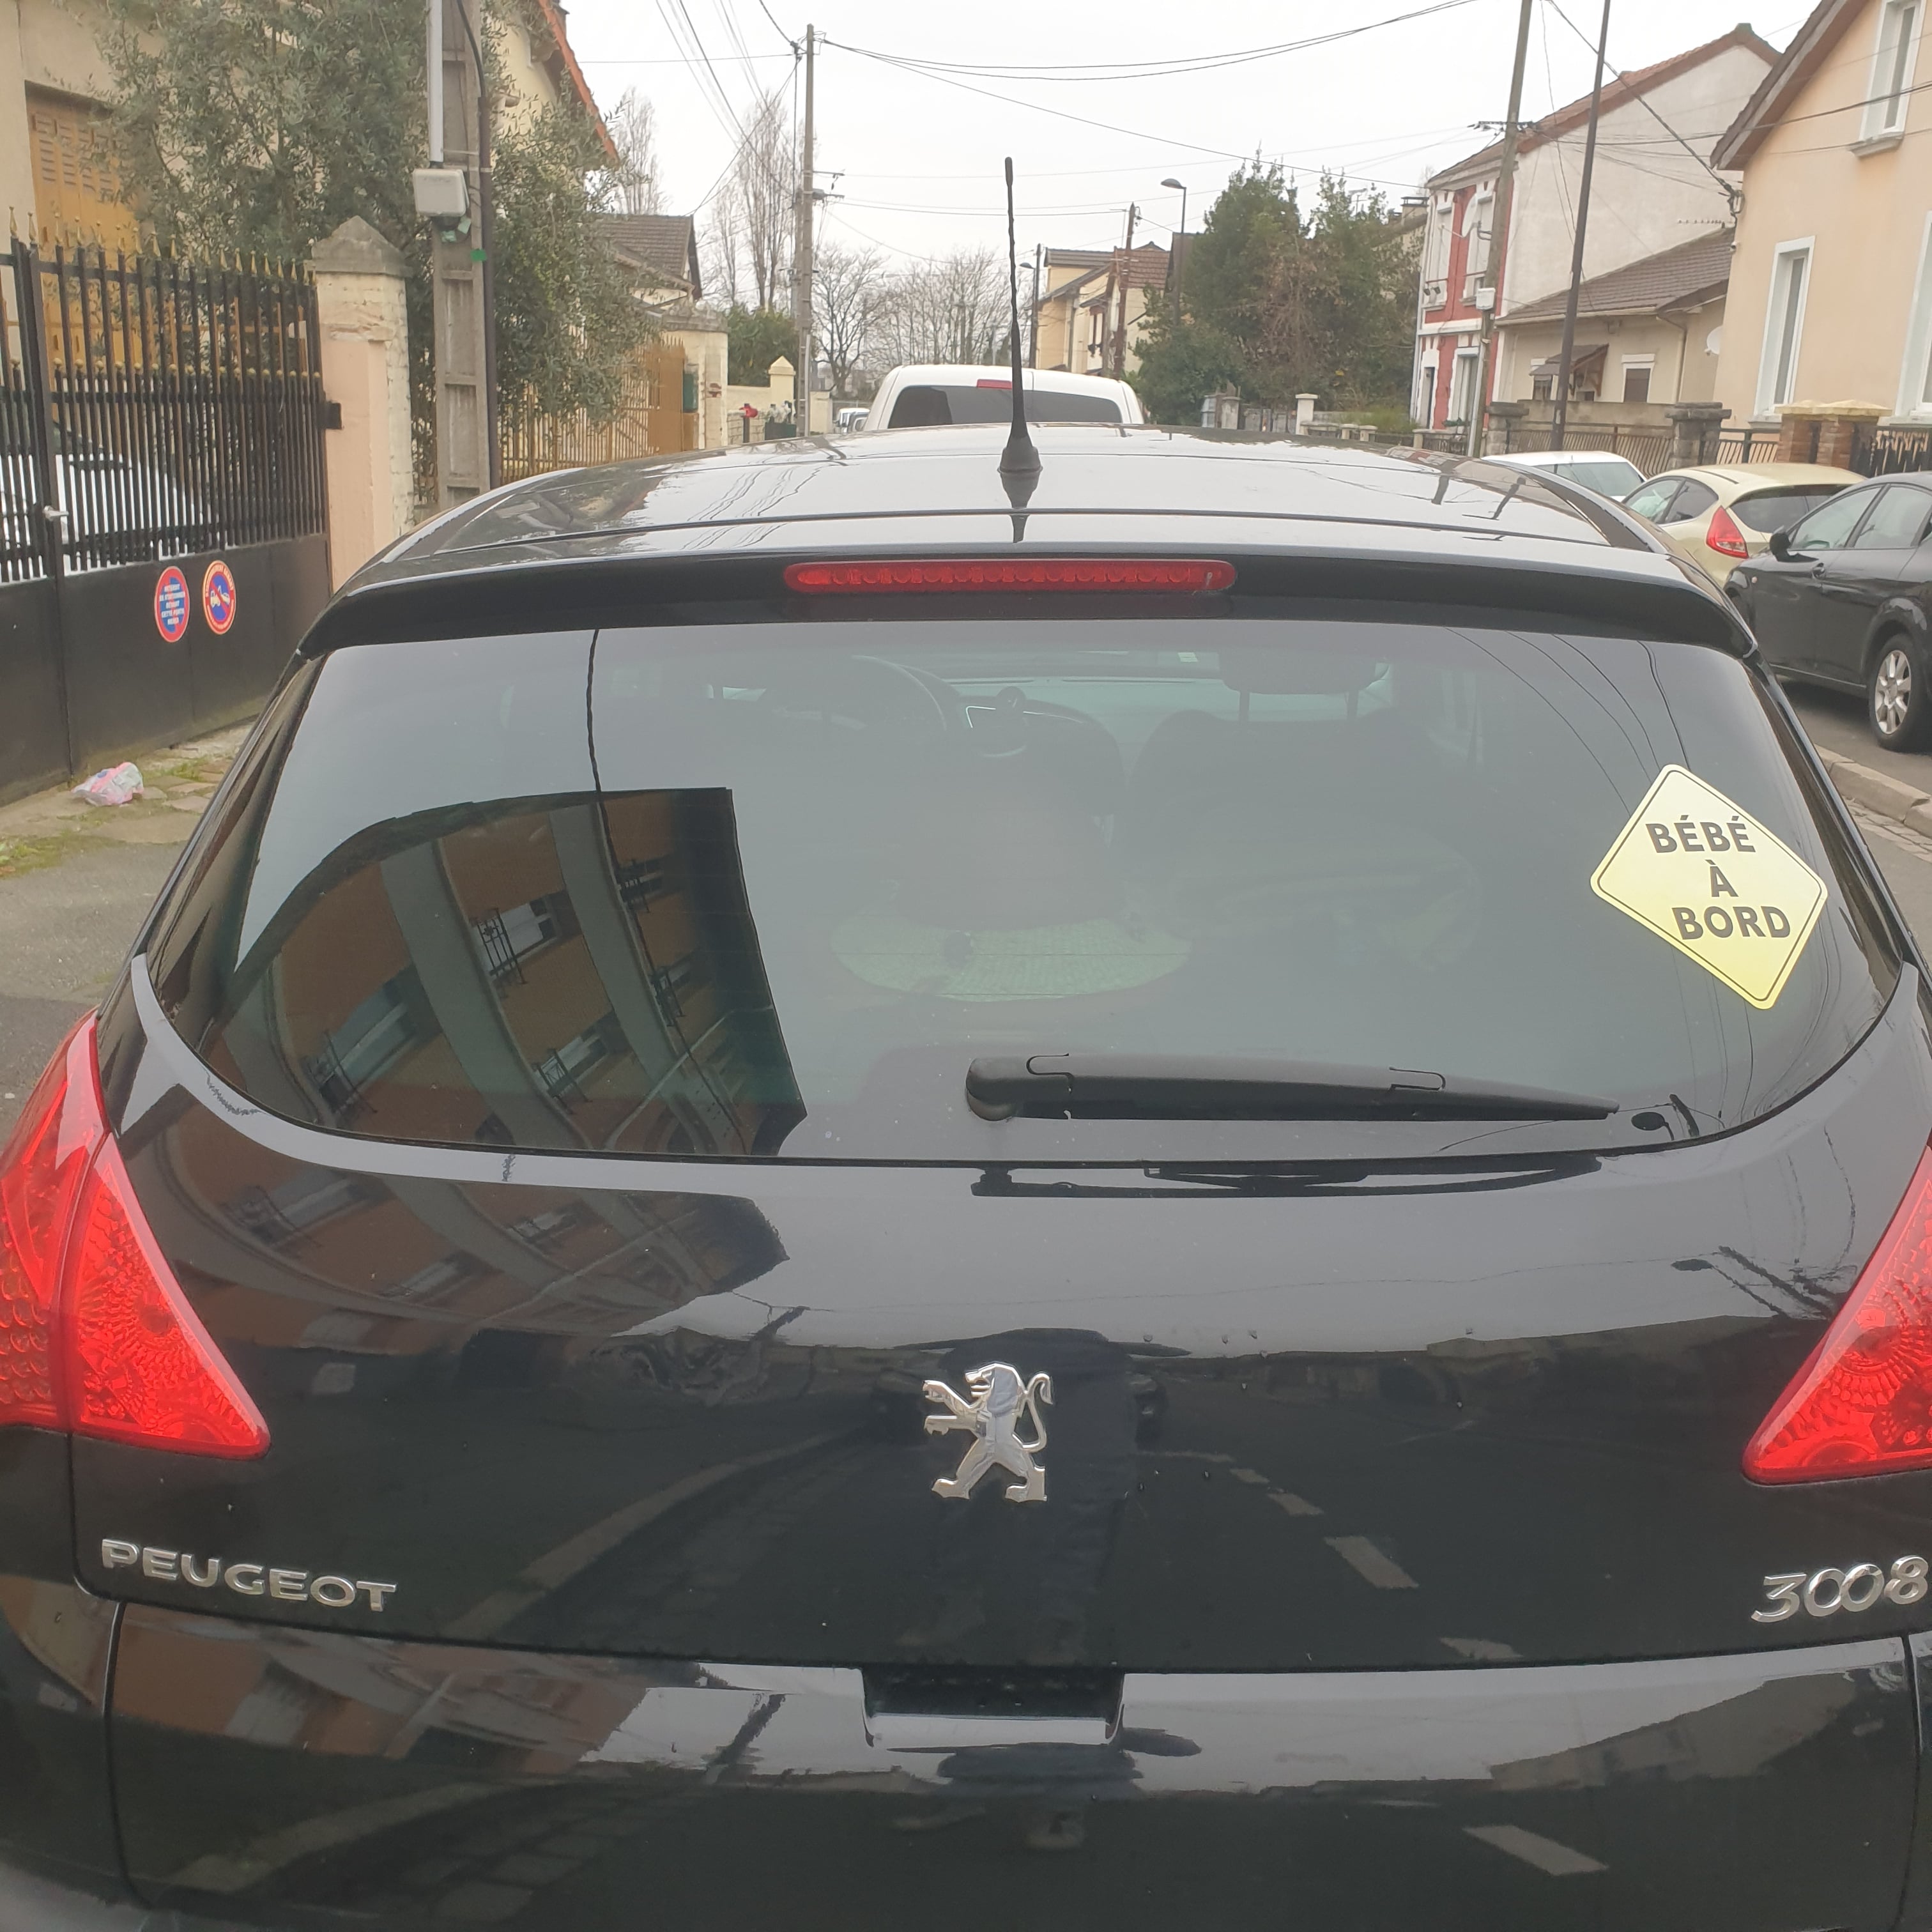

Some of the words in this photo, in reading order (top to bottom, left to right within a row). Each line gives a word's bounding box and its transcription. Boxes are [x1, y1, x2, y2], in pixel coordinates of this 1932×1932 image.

[1645, 815, 1756, 854] BÉBÉ
[1705, 859, 1739, 898] À
[1671, 905, 1791, 940] BORD
[102, 1538, 397, 1613] PEUGEOT
[1751, 1555, 1929, 1623] 3008
